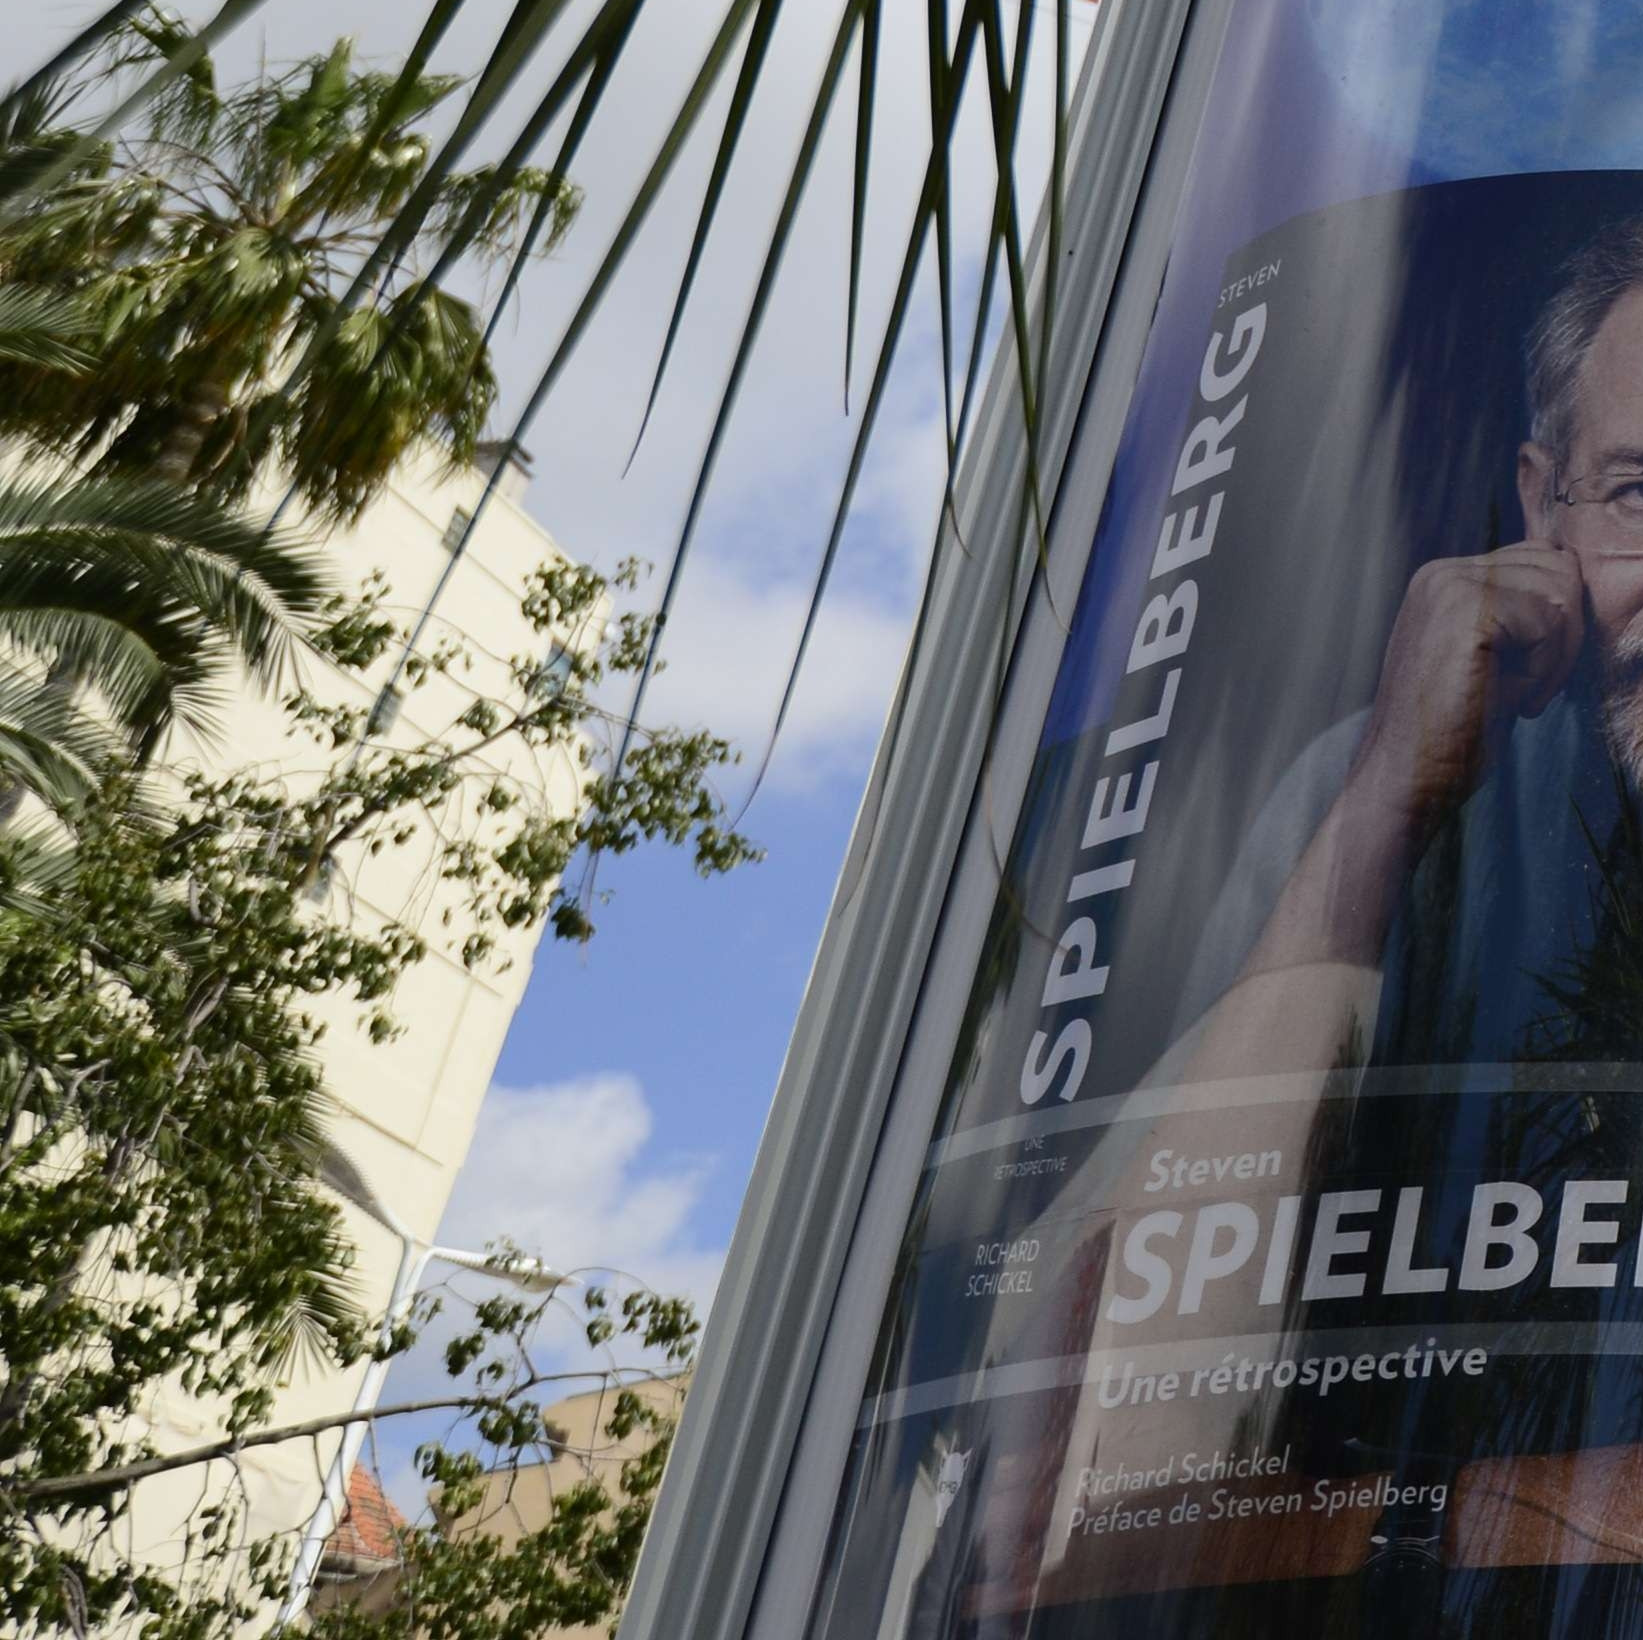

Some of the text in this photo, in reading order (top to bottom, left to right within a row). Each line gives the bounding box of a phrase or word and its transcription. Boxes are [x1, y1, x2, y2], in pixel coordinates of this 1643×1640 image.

[1217, 258, 1282, 309] STEVEN
[1020, 301, 1268, 1104] SPIELBERG
[1143, 1148, 1283, 1193] Steven
[975, 1239, 1040, 1265] RICHARD
[965, 1271, 1033, 1296] SCHICKEL
[1098, 1337, 1489, 1409] Une rétrospective
[1075, 1443, 1292, 1498] Richard Schickel
[1066, 1476, 1448, 1538] Préface de Steven Spielberg
